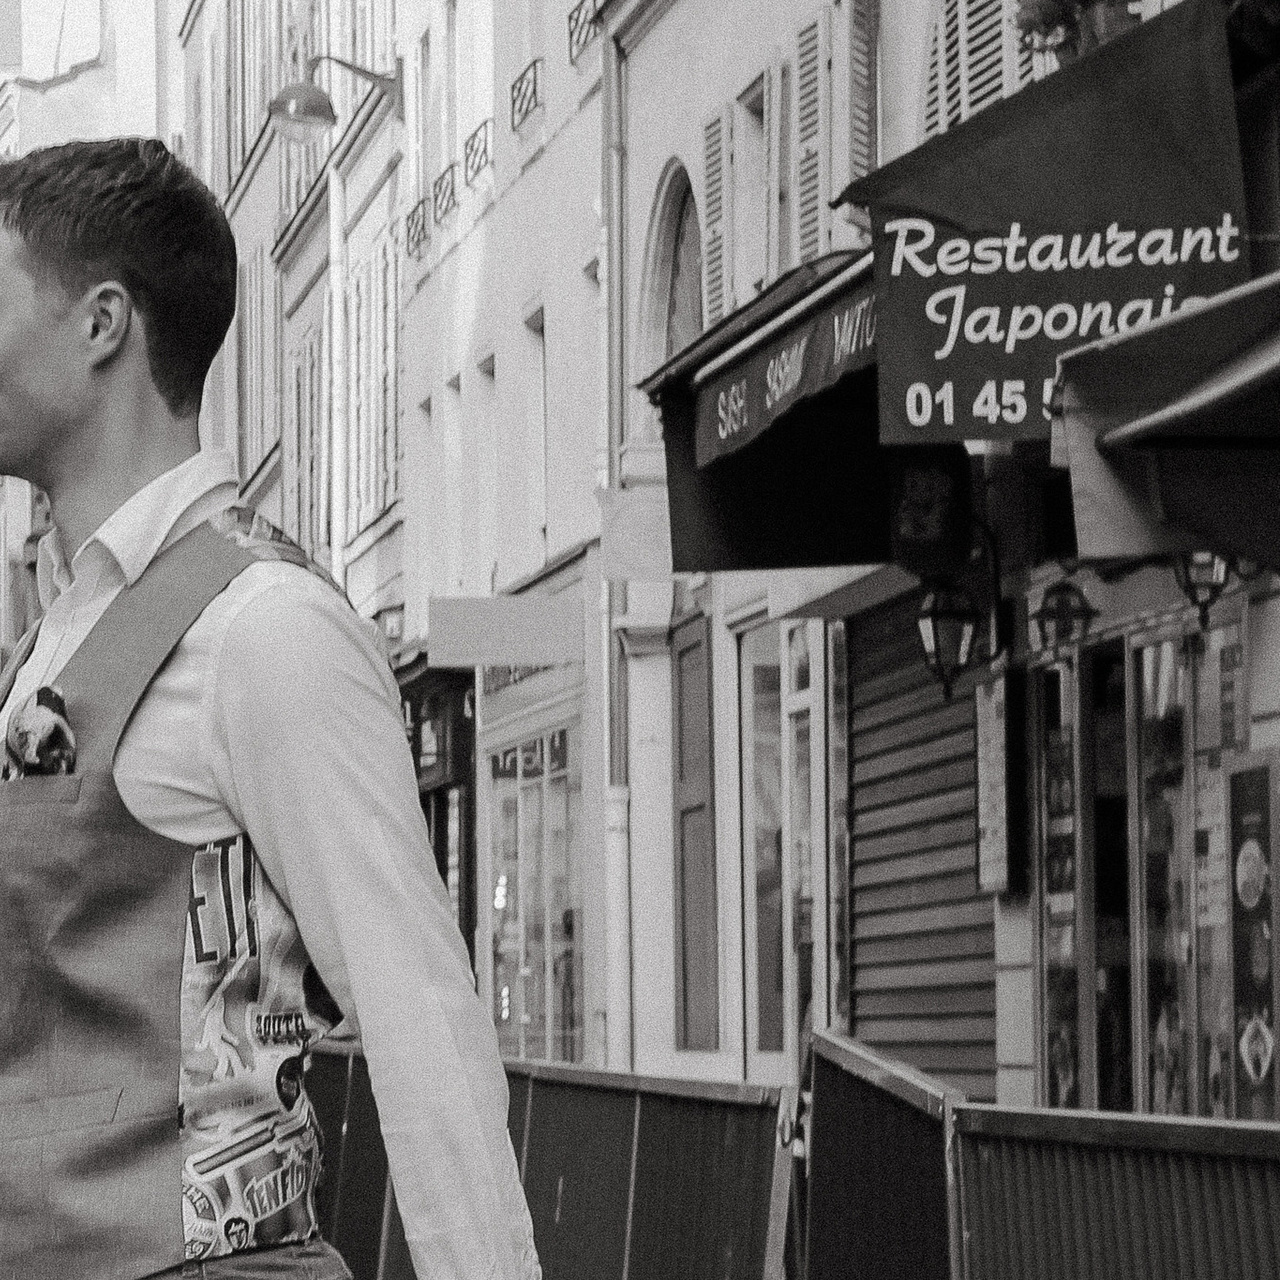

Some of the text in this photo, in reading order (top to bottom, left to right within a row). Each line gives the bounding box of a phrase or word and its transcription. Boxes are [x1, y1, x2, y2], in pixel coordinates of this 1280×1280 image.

[884, 212, 1241, 278] Restaurant
[905, 380, 955, 428] 01
[972, 378, 1028, 425] 45
